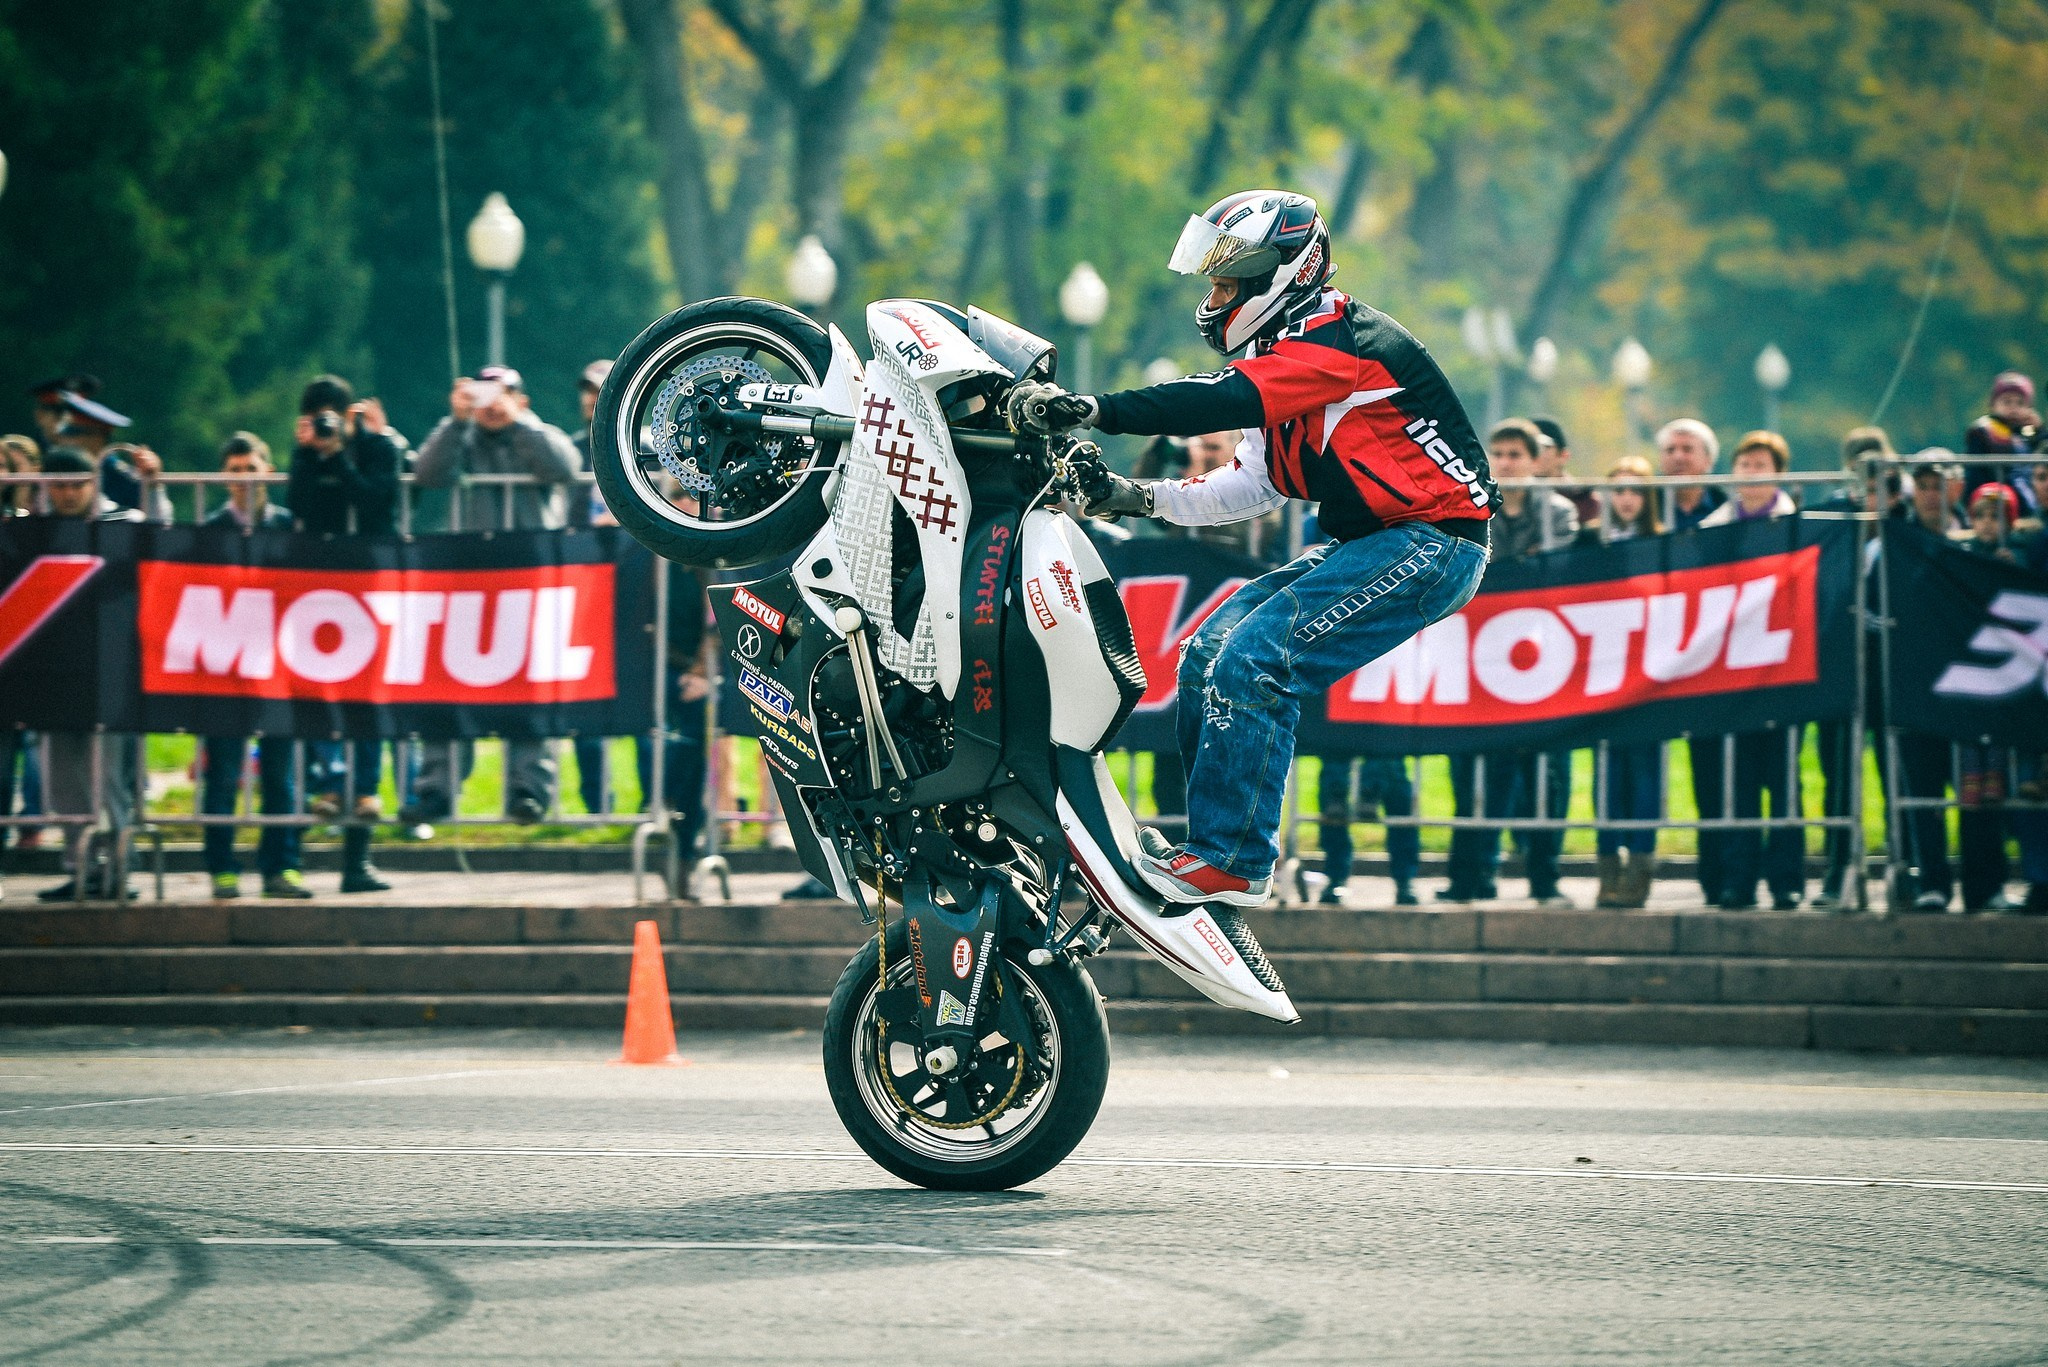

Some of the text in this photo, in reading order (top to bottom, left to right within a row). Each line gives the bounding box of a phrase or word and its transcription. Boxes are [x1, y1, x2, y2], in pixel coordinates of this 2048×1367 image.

[734, 587, 781, 631] MOTUL
[1027, 580, 1055, 629] MOTUL
[163, 584, 594, 687] MOTUL
[1350, 575, 1793, 705] MOTUL
[741, 673, 787, 713] PATA
[789, 708, 811, 734] AB
[750, 703, 816, 760] KURBADS
[956, 944, 965, 971] HEL
[1195, 919, 1233, 965] MOTUL
[965, 931, 995, 1026] helperformance.com
